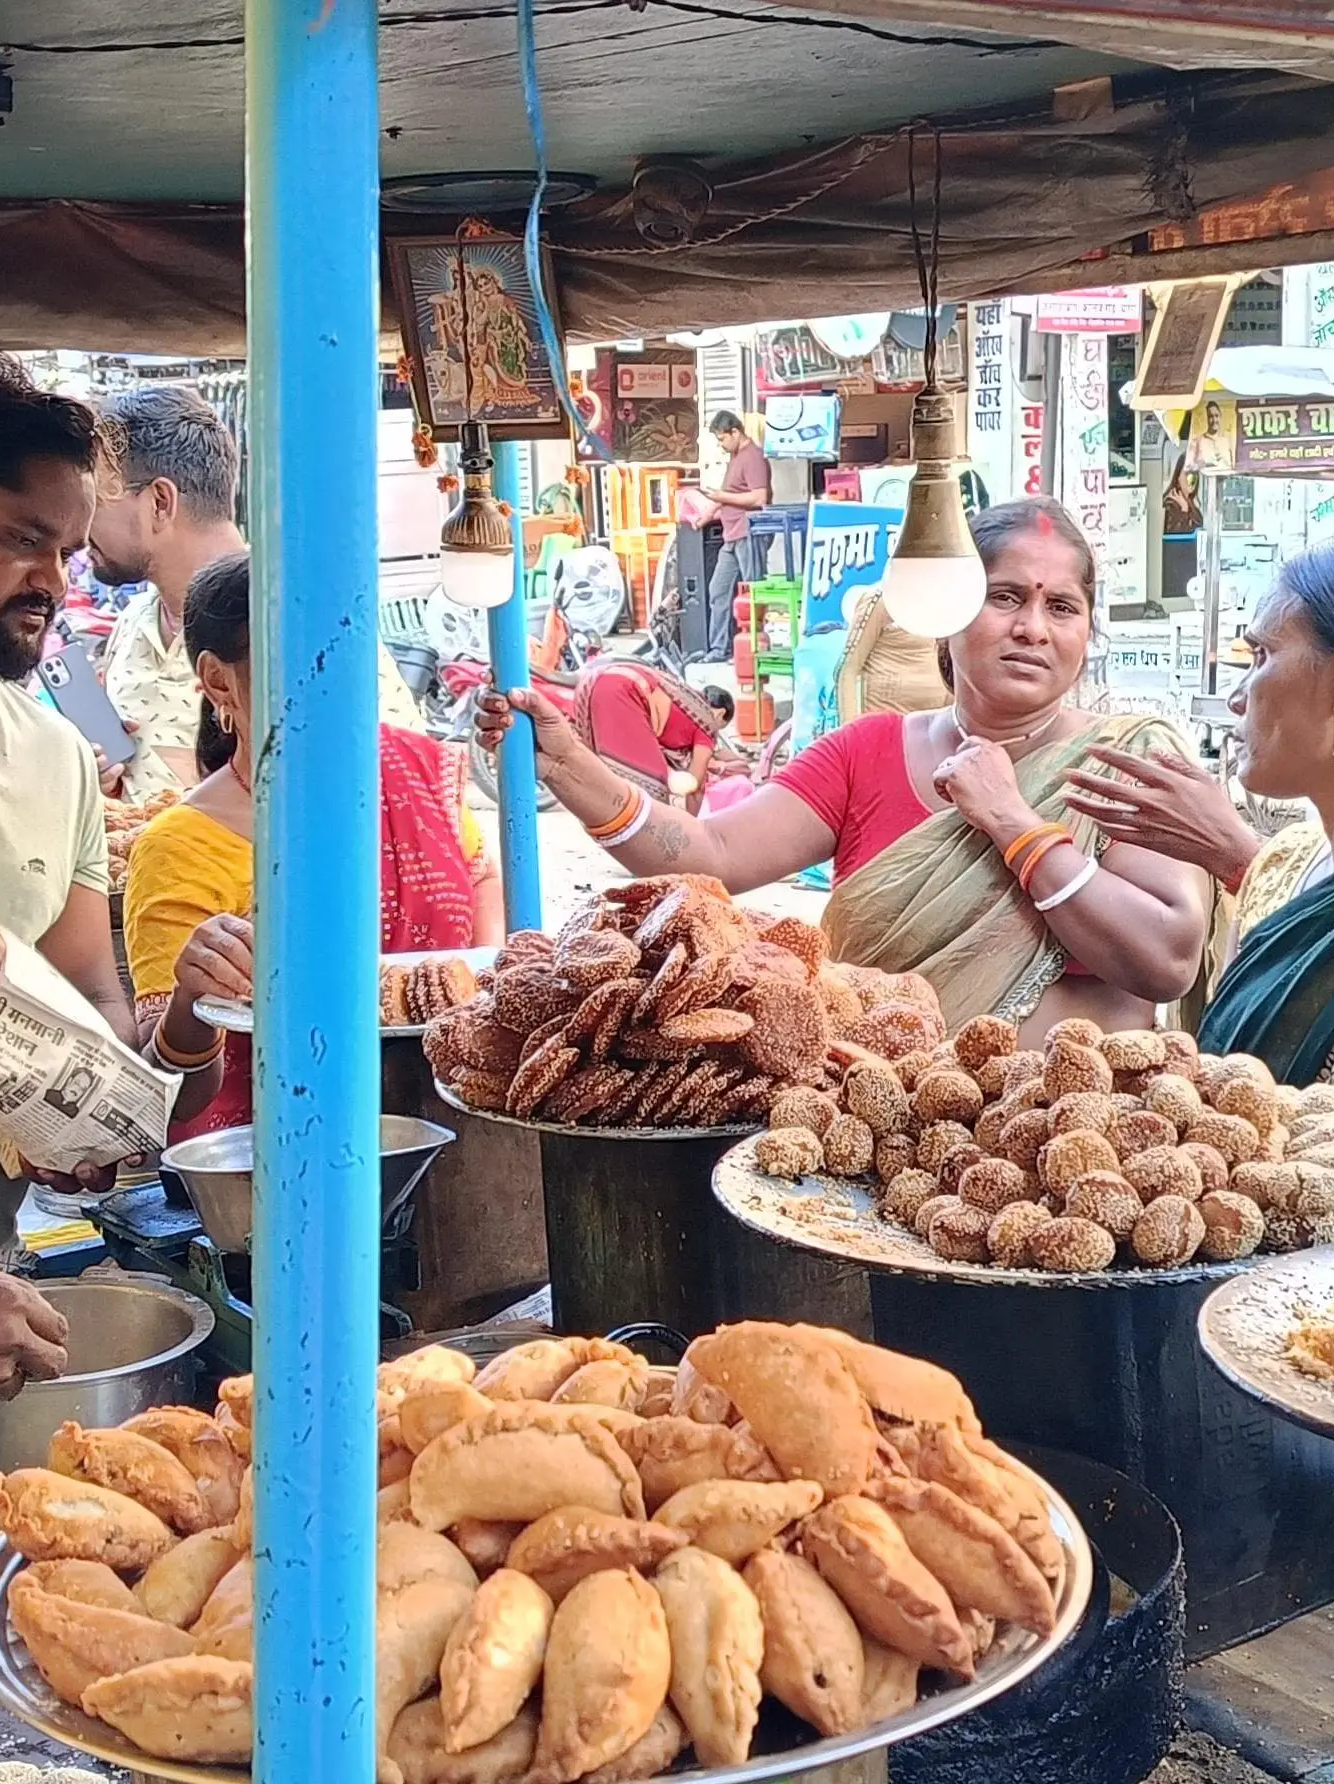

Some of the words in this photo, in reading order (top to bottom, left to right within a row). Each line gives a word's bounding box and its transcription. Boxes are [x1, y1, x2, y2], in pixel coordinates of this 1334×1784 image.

[975, 386, 1002, 408] कर
[1238, 396, 1300, 438] शंकर
[6, 1006, 67, 1048] मनमानी
